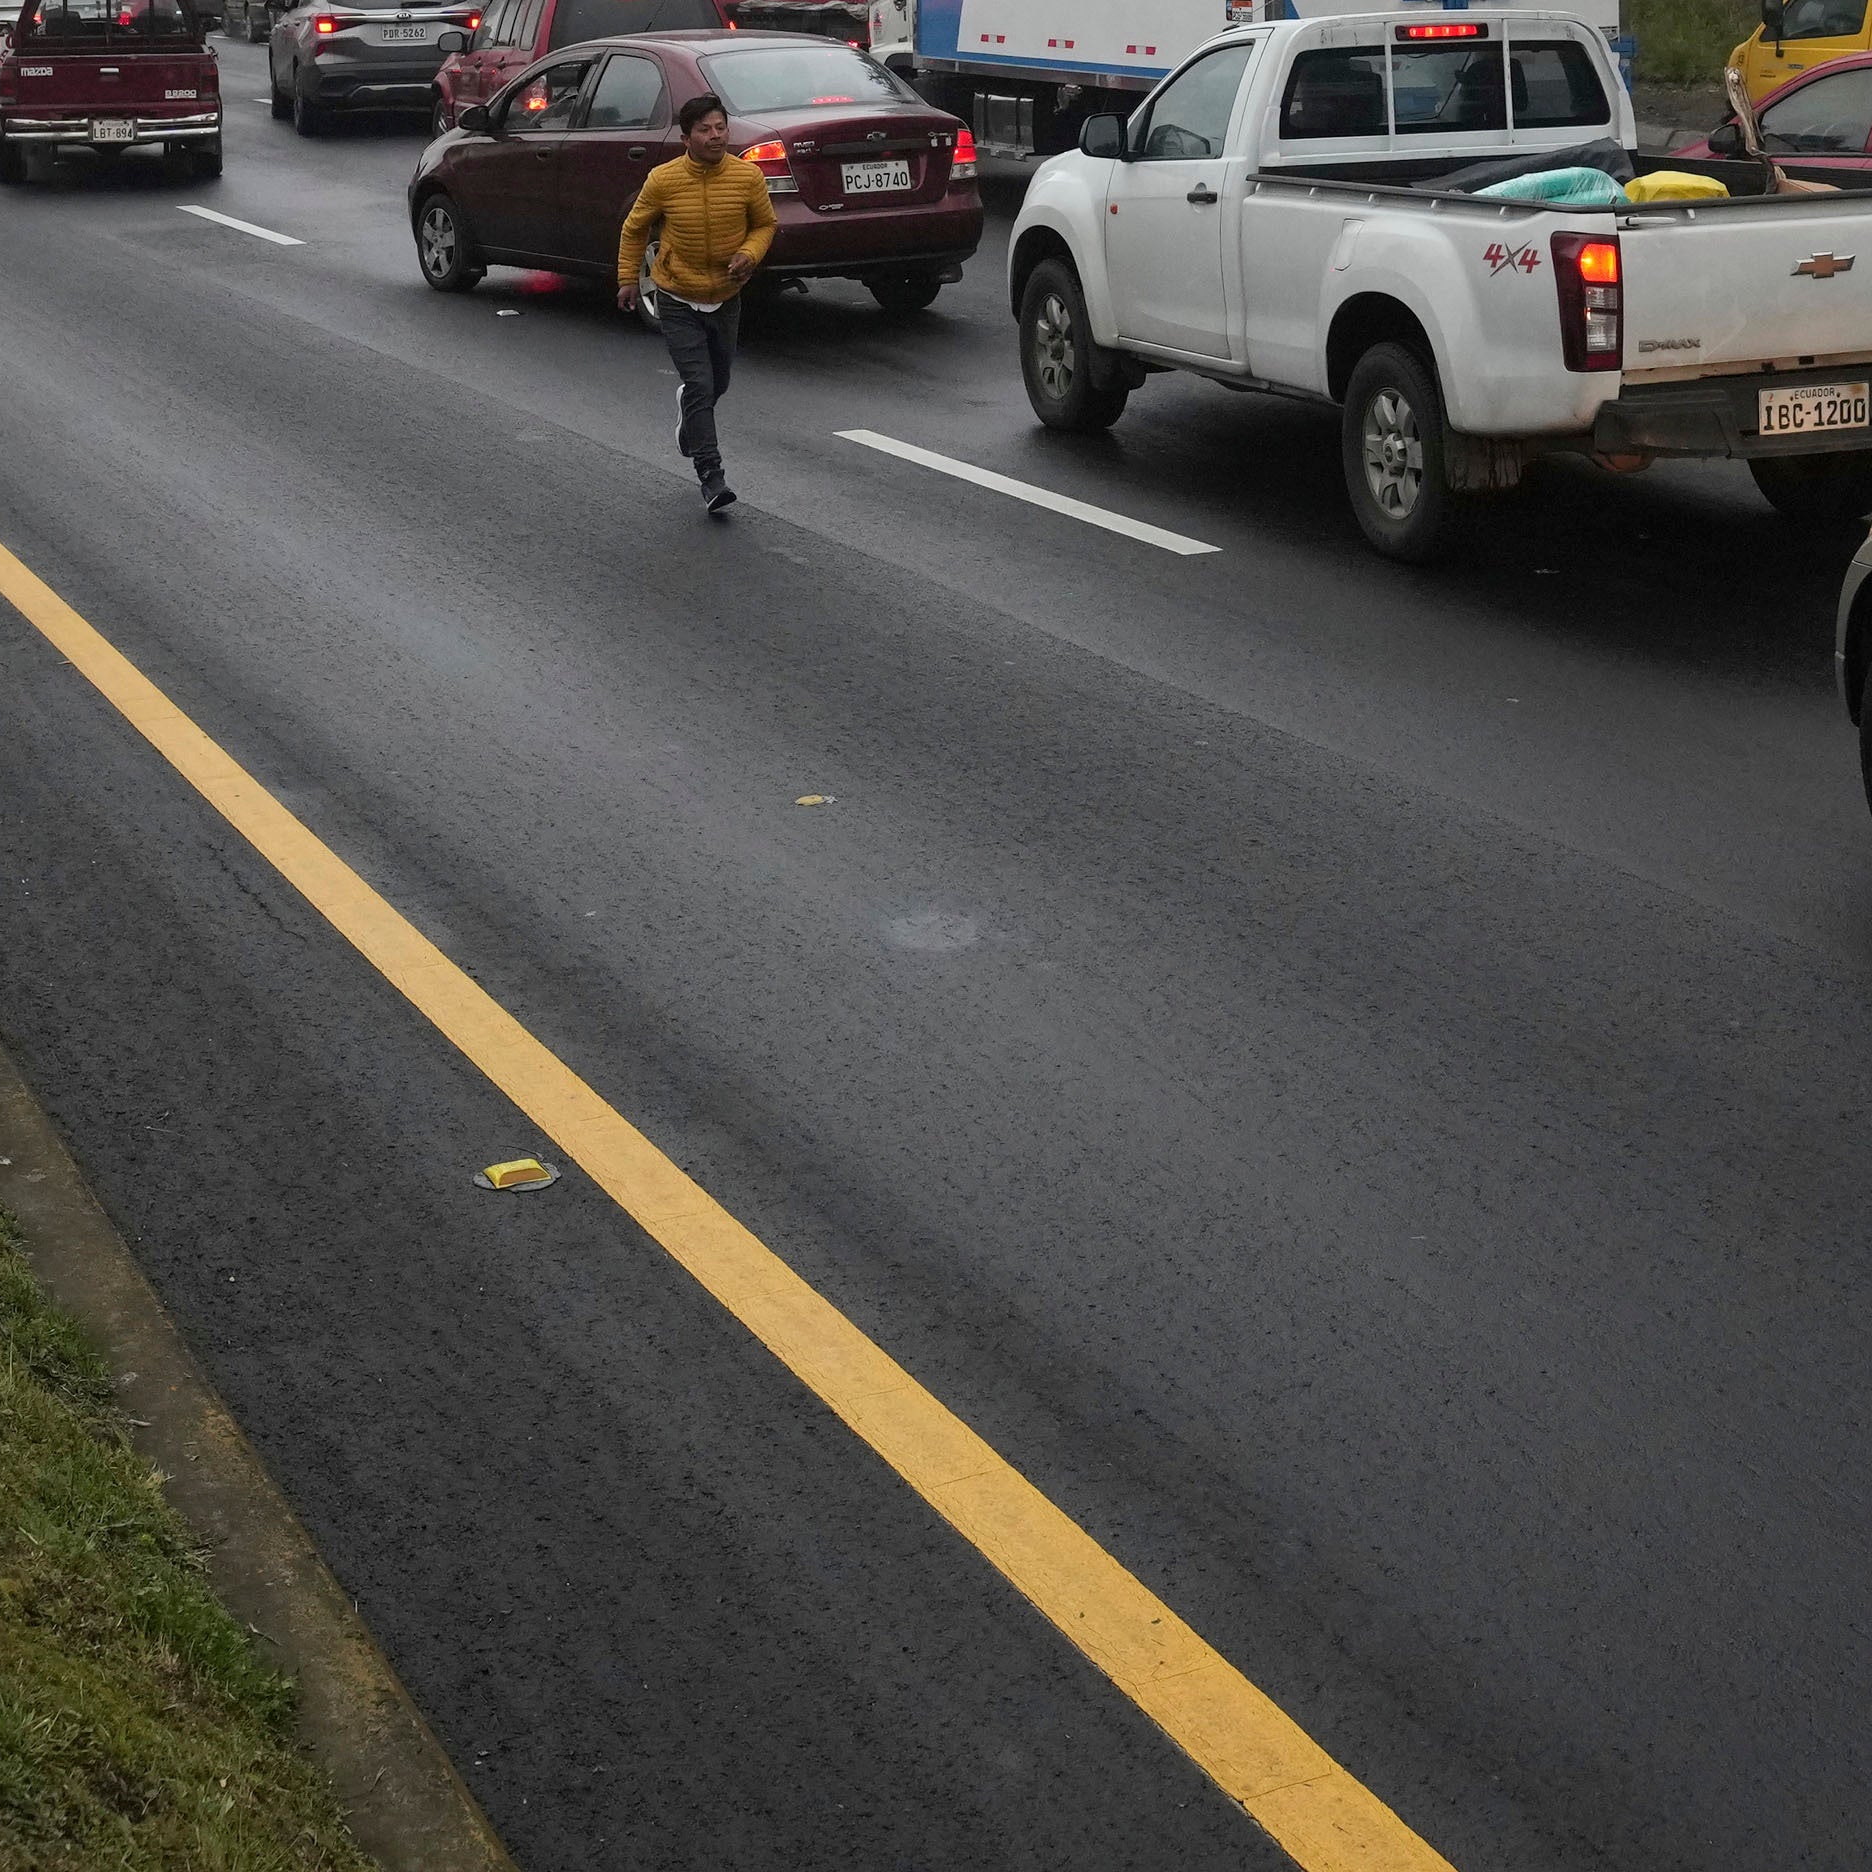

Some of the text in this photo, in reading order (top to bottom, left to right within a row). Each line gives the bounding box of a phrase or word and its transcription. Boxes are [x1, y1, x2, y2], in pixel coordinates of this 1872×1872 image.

[862, 162, 888, 171] ECUADOR
[845, 171, 908, 190] PCJ-8740
[1794, 387, 1835, 400] ECUADOR
[1763, 398, 1866, 431] IBC-1200
